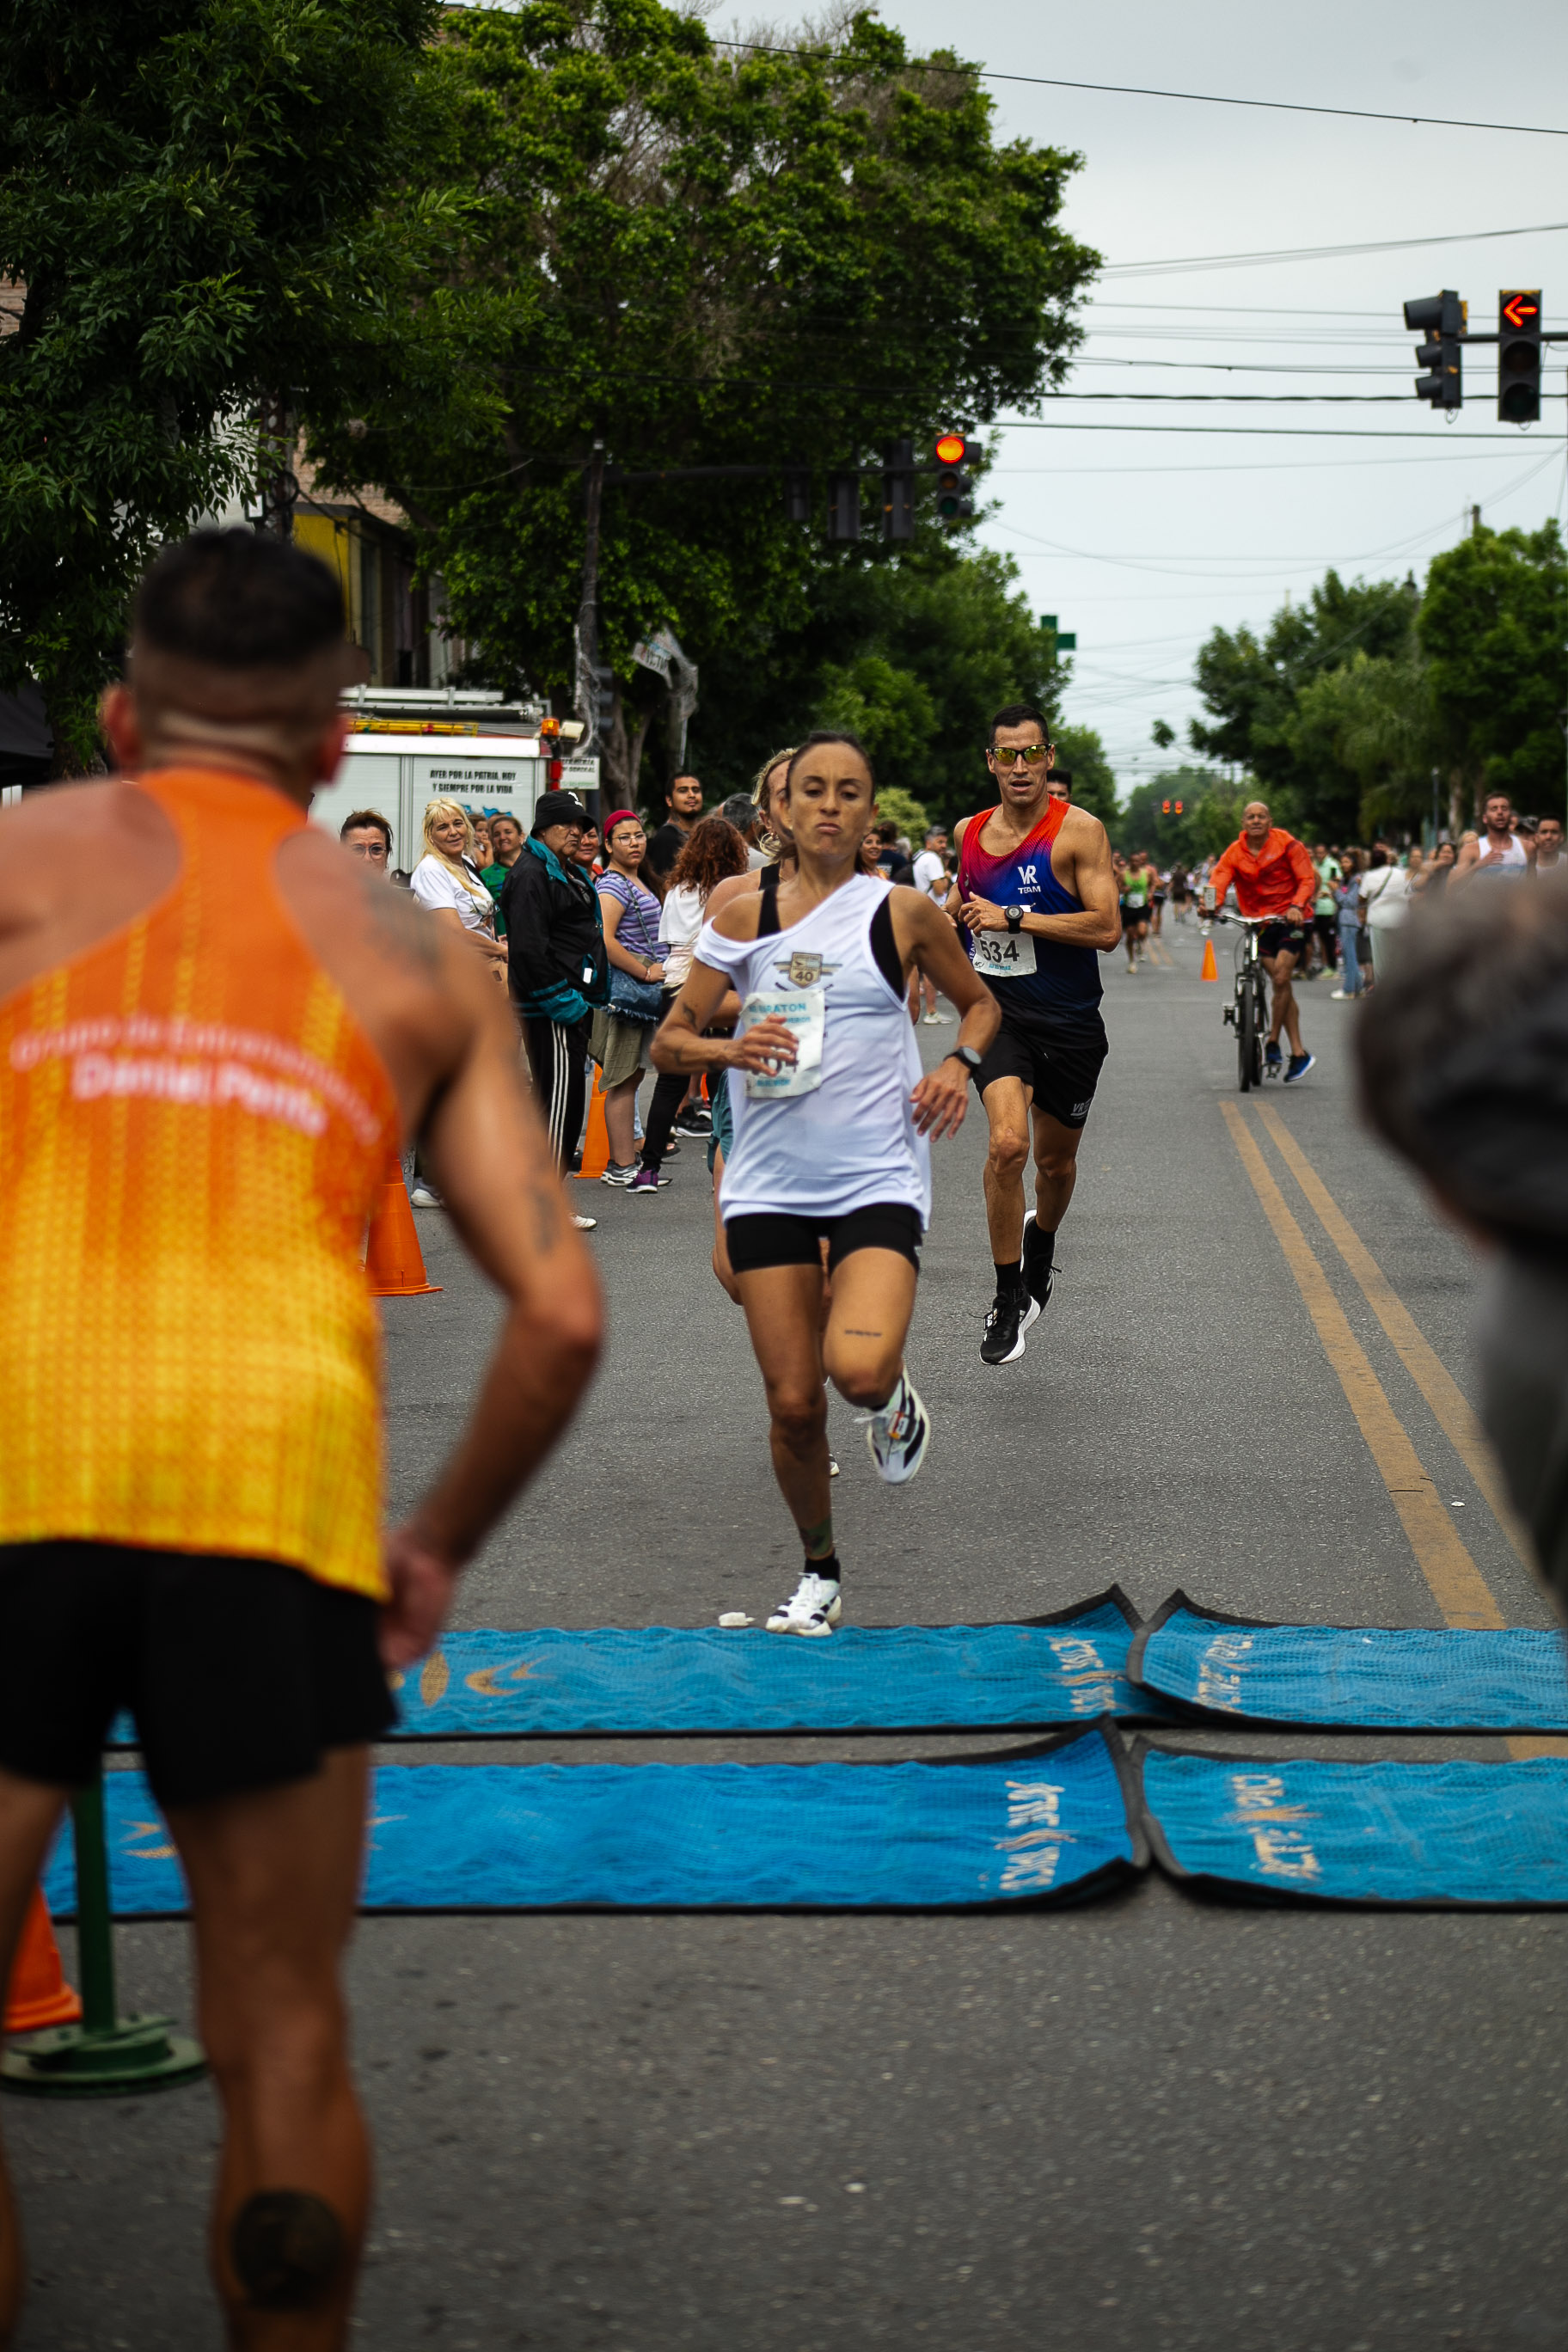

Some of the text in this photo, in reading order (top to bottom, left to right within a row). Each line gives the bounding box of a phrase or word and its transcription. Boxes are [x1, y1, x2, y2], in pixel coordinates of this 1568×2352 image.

[430, 769, 447, 779] AYER
[449, 770, 463, 780] POR
[465, 770, 473, 780] LA
[502, 772, 517, 781] HOY
[432, 783, 513, 794] Y SIEMPRE POR LA VIDA
[1018, 865, 1038, 885] VR
[1018, 885, 1041, 894] TEAM
[980, 940, 1020, 963] 534
[795, 971, 814, 982] 40
